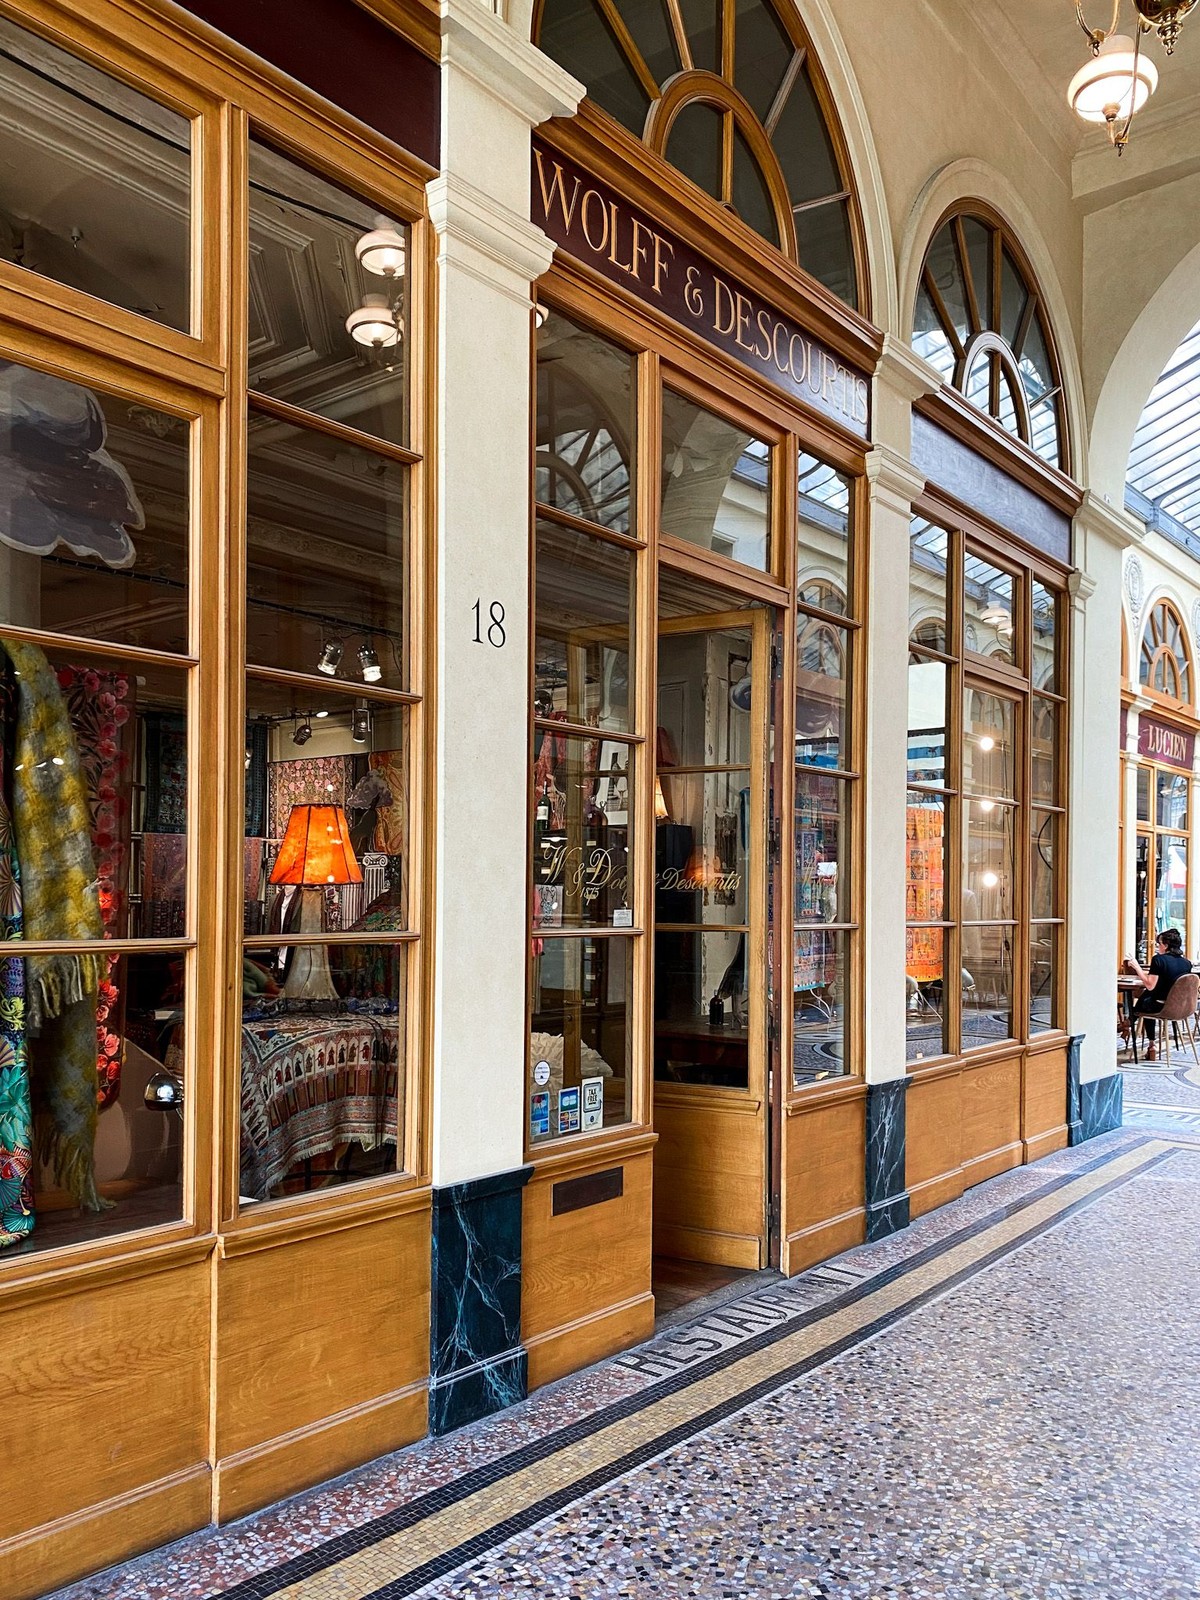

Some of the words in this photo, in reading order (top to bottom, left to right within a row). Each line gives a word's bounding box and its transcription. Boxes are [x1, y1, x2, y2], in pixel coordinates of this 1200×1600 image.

[532, 147, 676, 296] WOLFF
[683, 265, 704, 317] &
[712, 275, 868, 425] DESCOURTIS
[471, 597, 506, 648] 18
[1147, 724, 1188, 762] LUCIEN
[543, 845, 582, 884] W
[586, 847, 614, 886] D
[588, 1088, 597, 1096] TAX
